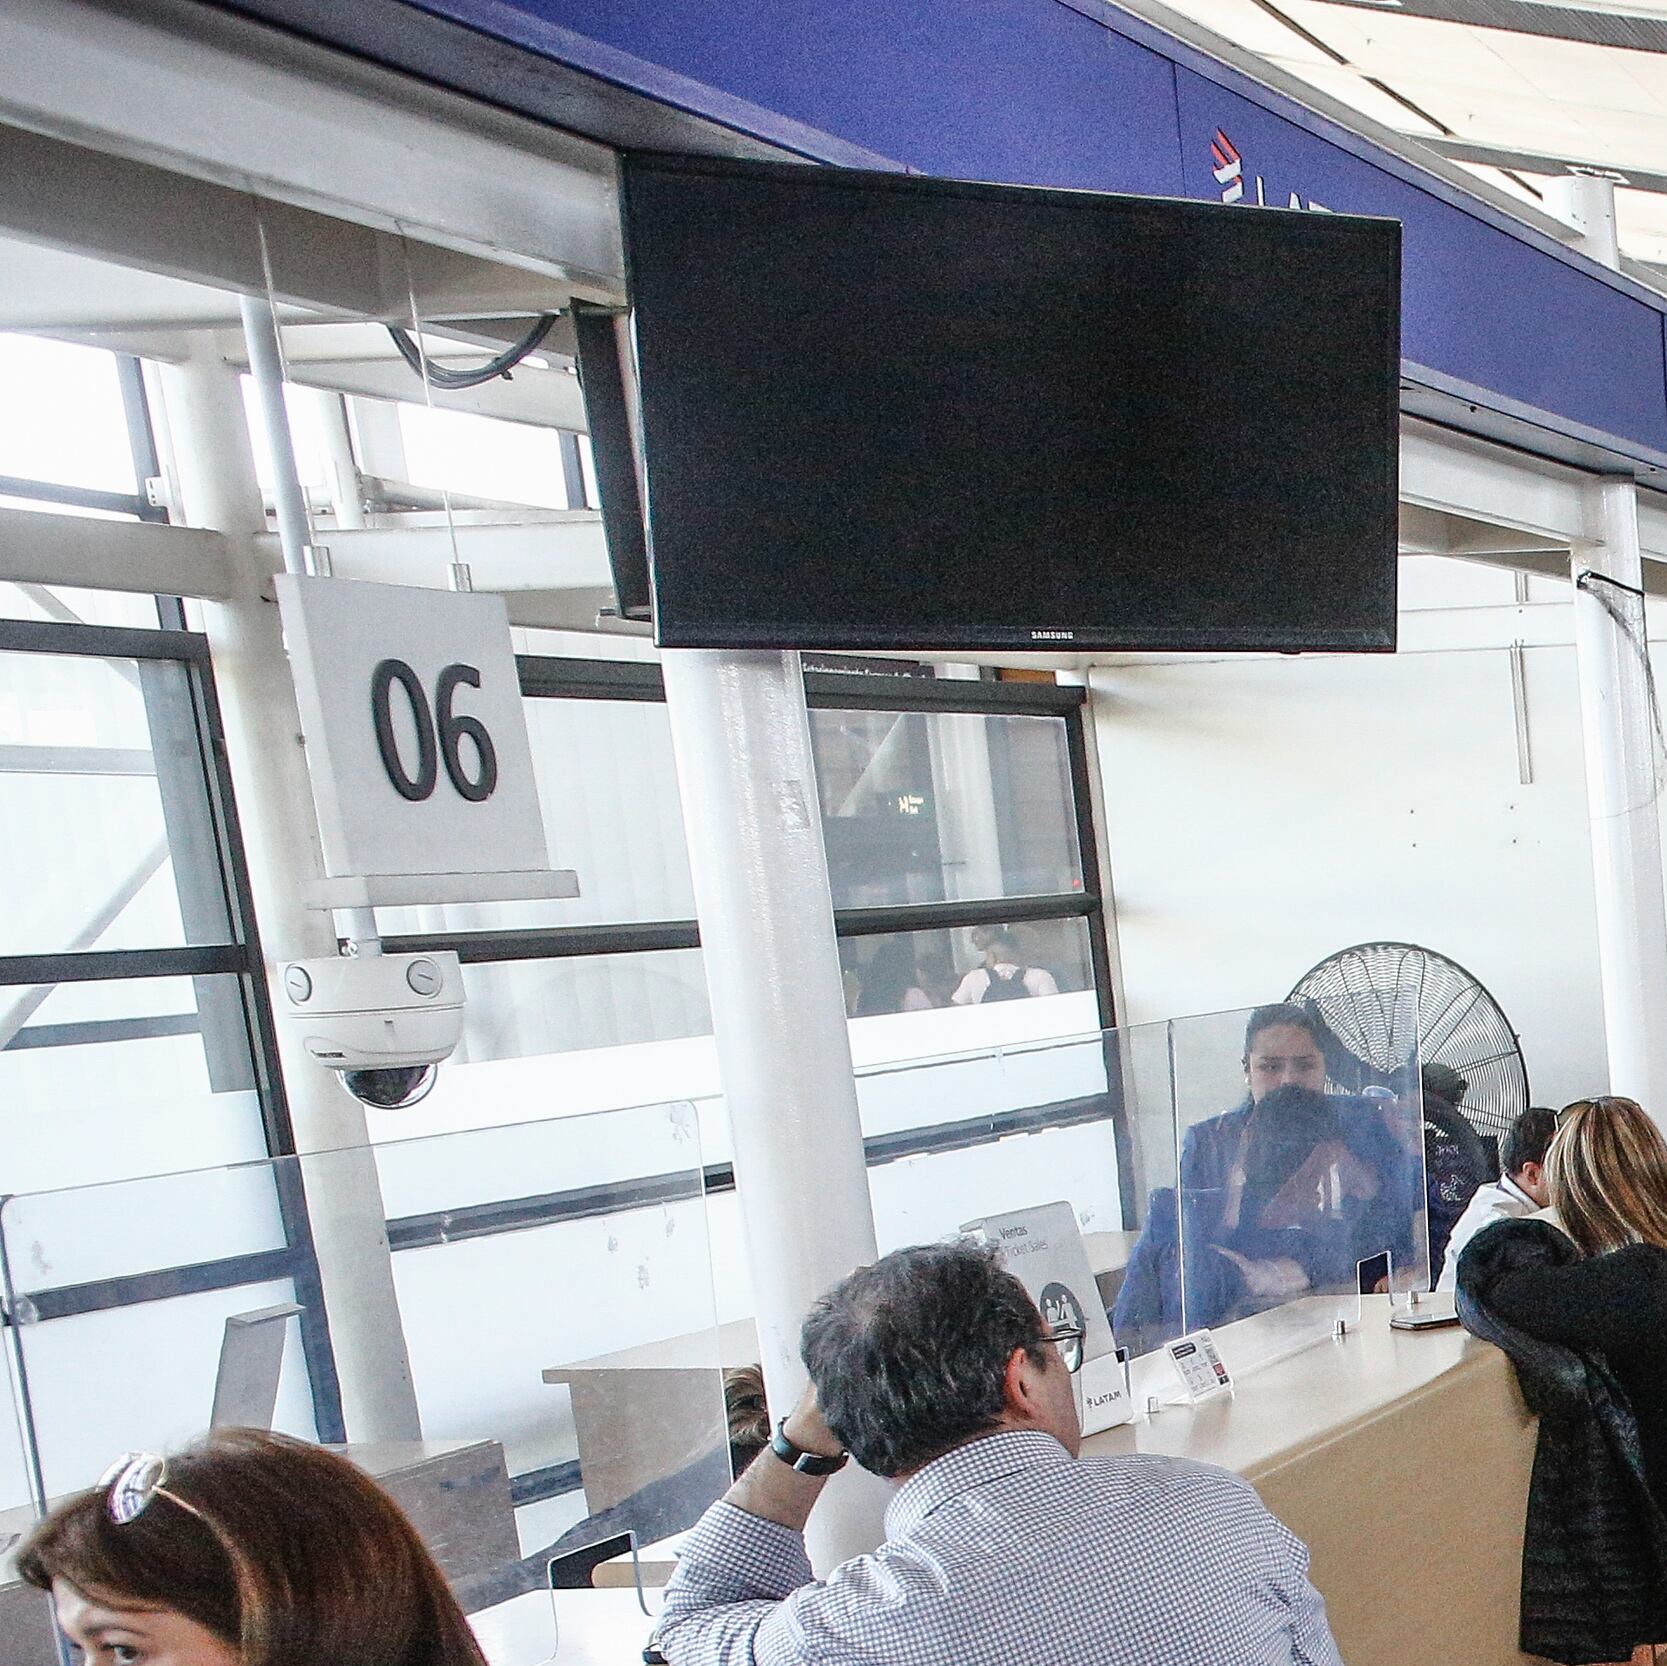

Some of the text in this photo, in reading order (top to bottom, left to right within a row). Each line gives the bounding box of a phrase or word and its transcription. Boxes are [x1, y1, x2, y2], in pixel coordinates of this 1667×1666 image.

[1030, 630, 1074, 641] SAMSUNG
[371, 656, 498, 804] 06
[998, 1225, 1029, 1241] Ventas
[1093, 1389, 1122, 1406] LATAM
